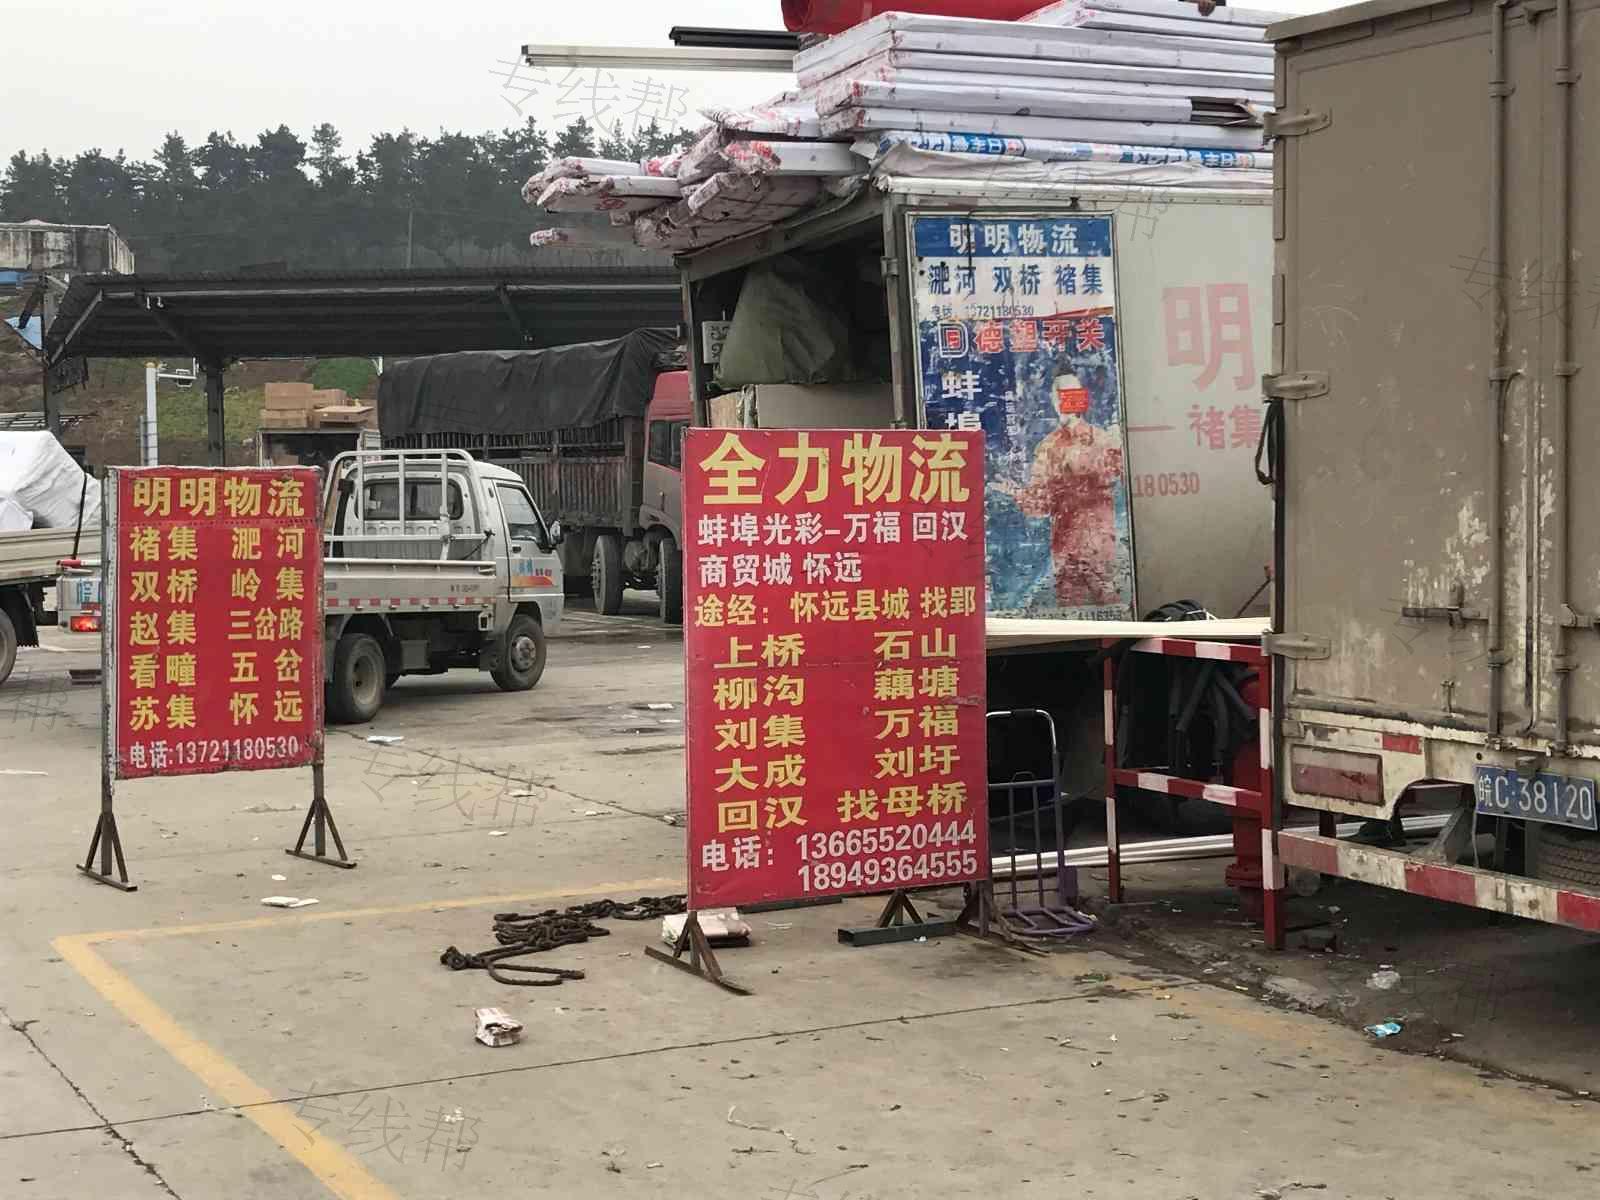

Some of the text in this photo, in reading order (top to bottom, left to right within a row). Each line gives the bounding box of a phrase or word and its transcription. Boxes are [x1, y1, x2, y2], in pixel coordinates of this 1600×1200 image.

[993, 264, 1041, 296] 双桥
[1162, 283, 1256, 392] 明
[699, 431, 970, 506] 全力物流
[133, 477, 304, 517] 明明物流
[130, 526, 305, 562] 褚集 淝河
[912, 510, 968, 541] 回汉
[130, 568, 198, 603] 双桥
[231, 567, 304, 602] 岭集
[699, 551, 863, 588] 商贸城 怀远
[789, 587, 910, 623] 怀远县城
[920, 585, 976, 618] 找郢
[129, 607, 304, 646] 赵集 三岔路
[230, 648, 304, 683] 五岔
[712, 627, 957, 670] 上桥 石山
[712, 665, 960, 712] 柳沟 藕塘
[129, 690, 303, 732] 苏集 怀远
[714, 704, 959, 751] 刘集 万福
[714, 744, 960, 793] 大成 刘圩
[718, 781, 968, 833] 回汉 找母桥
[795, 819, 977, 862] 13665520444
[798, 849, 977, 892] 18949364555
